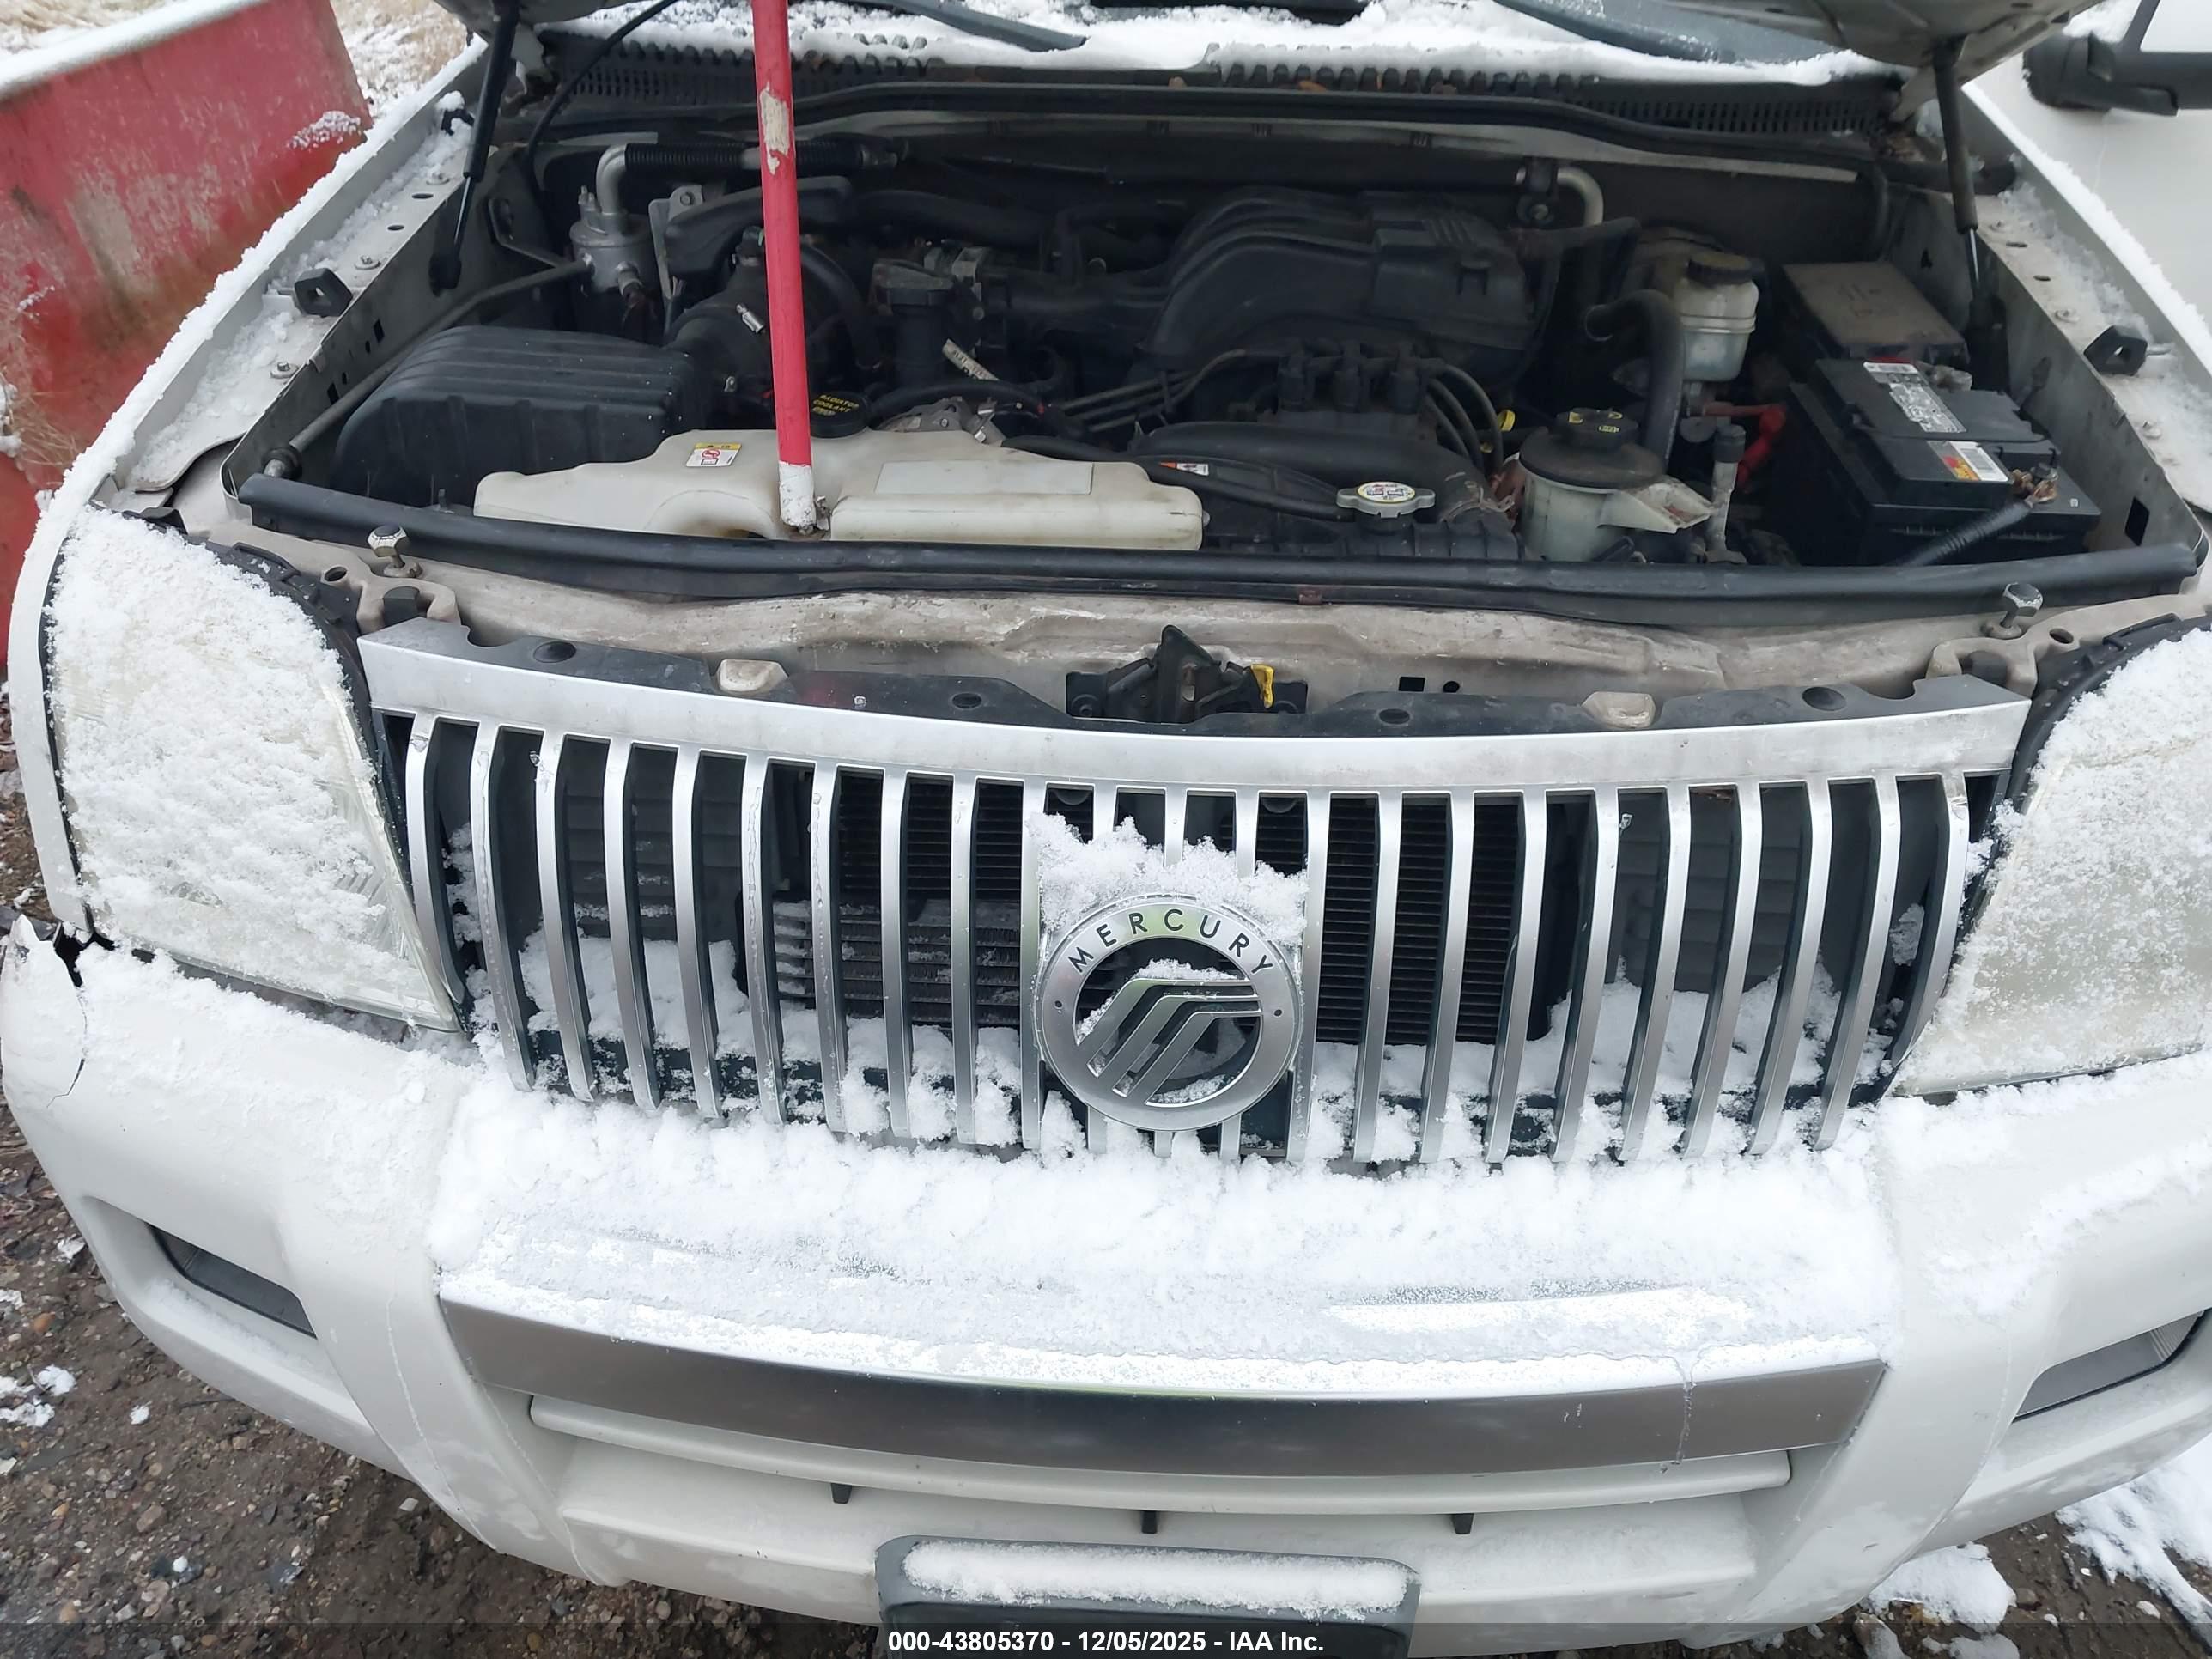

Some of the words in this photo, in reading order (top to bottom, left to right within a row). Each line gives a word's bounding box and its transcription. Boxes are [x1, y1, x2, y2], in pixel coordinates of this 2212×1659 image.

[812, 398, 851, 413] COOLANT
[819, 394, 860, 409] RADIATOR
[1067, 908, 1274, 975] MERCURY
